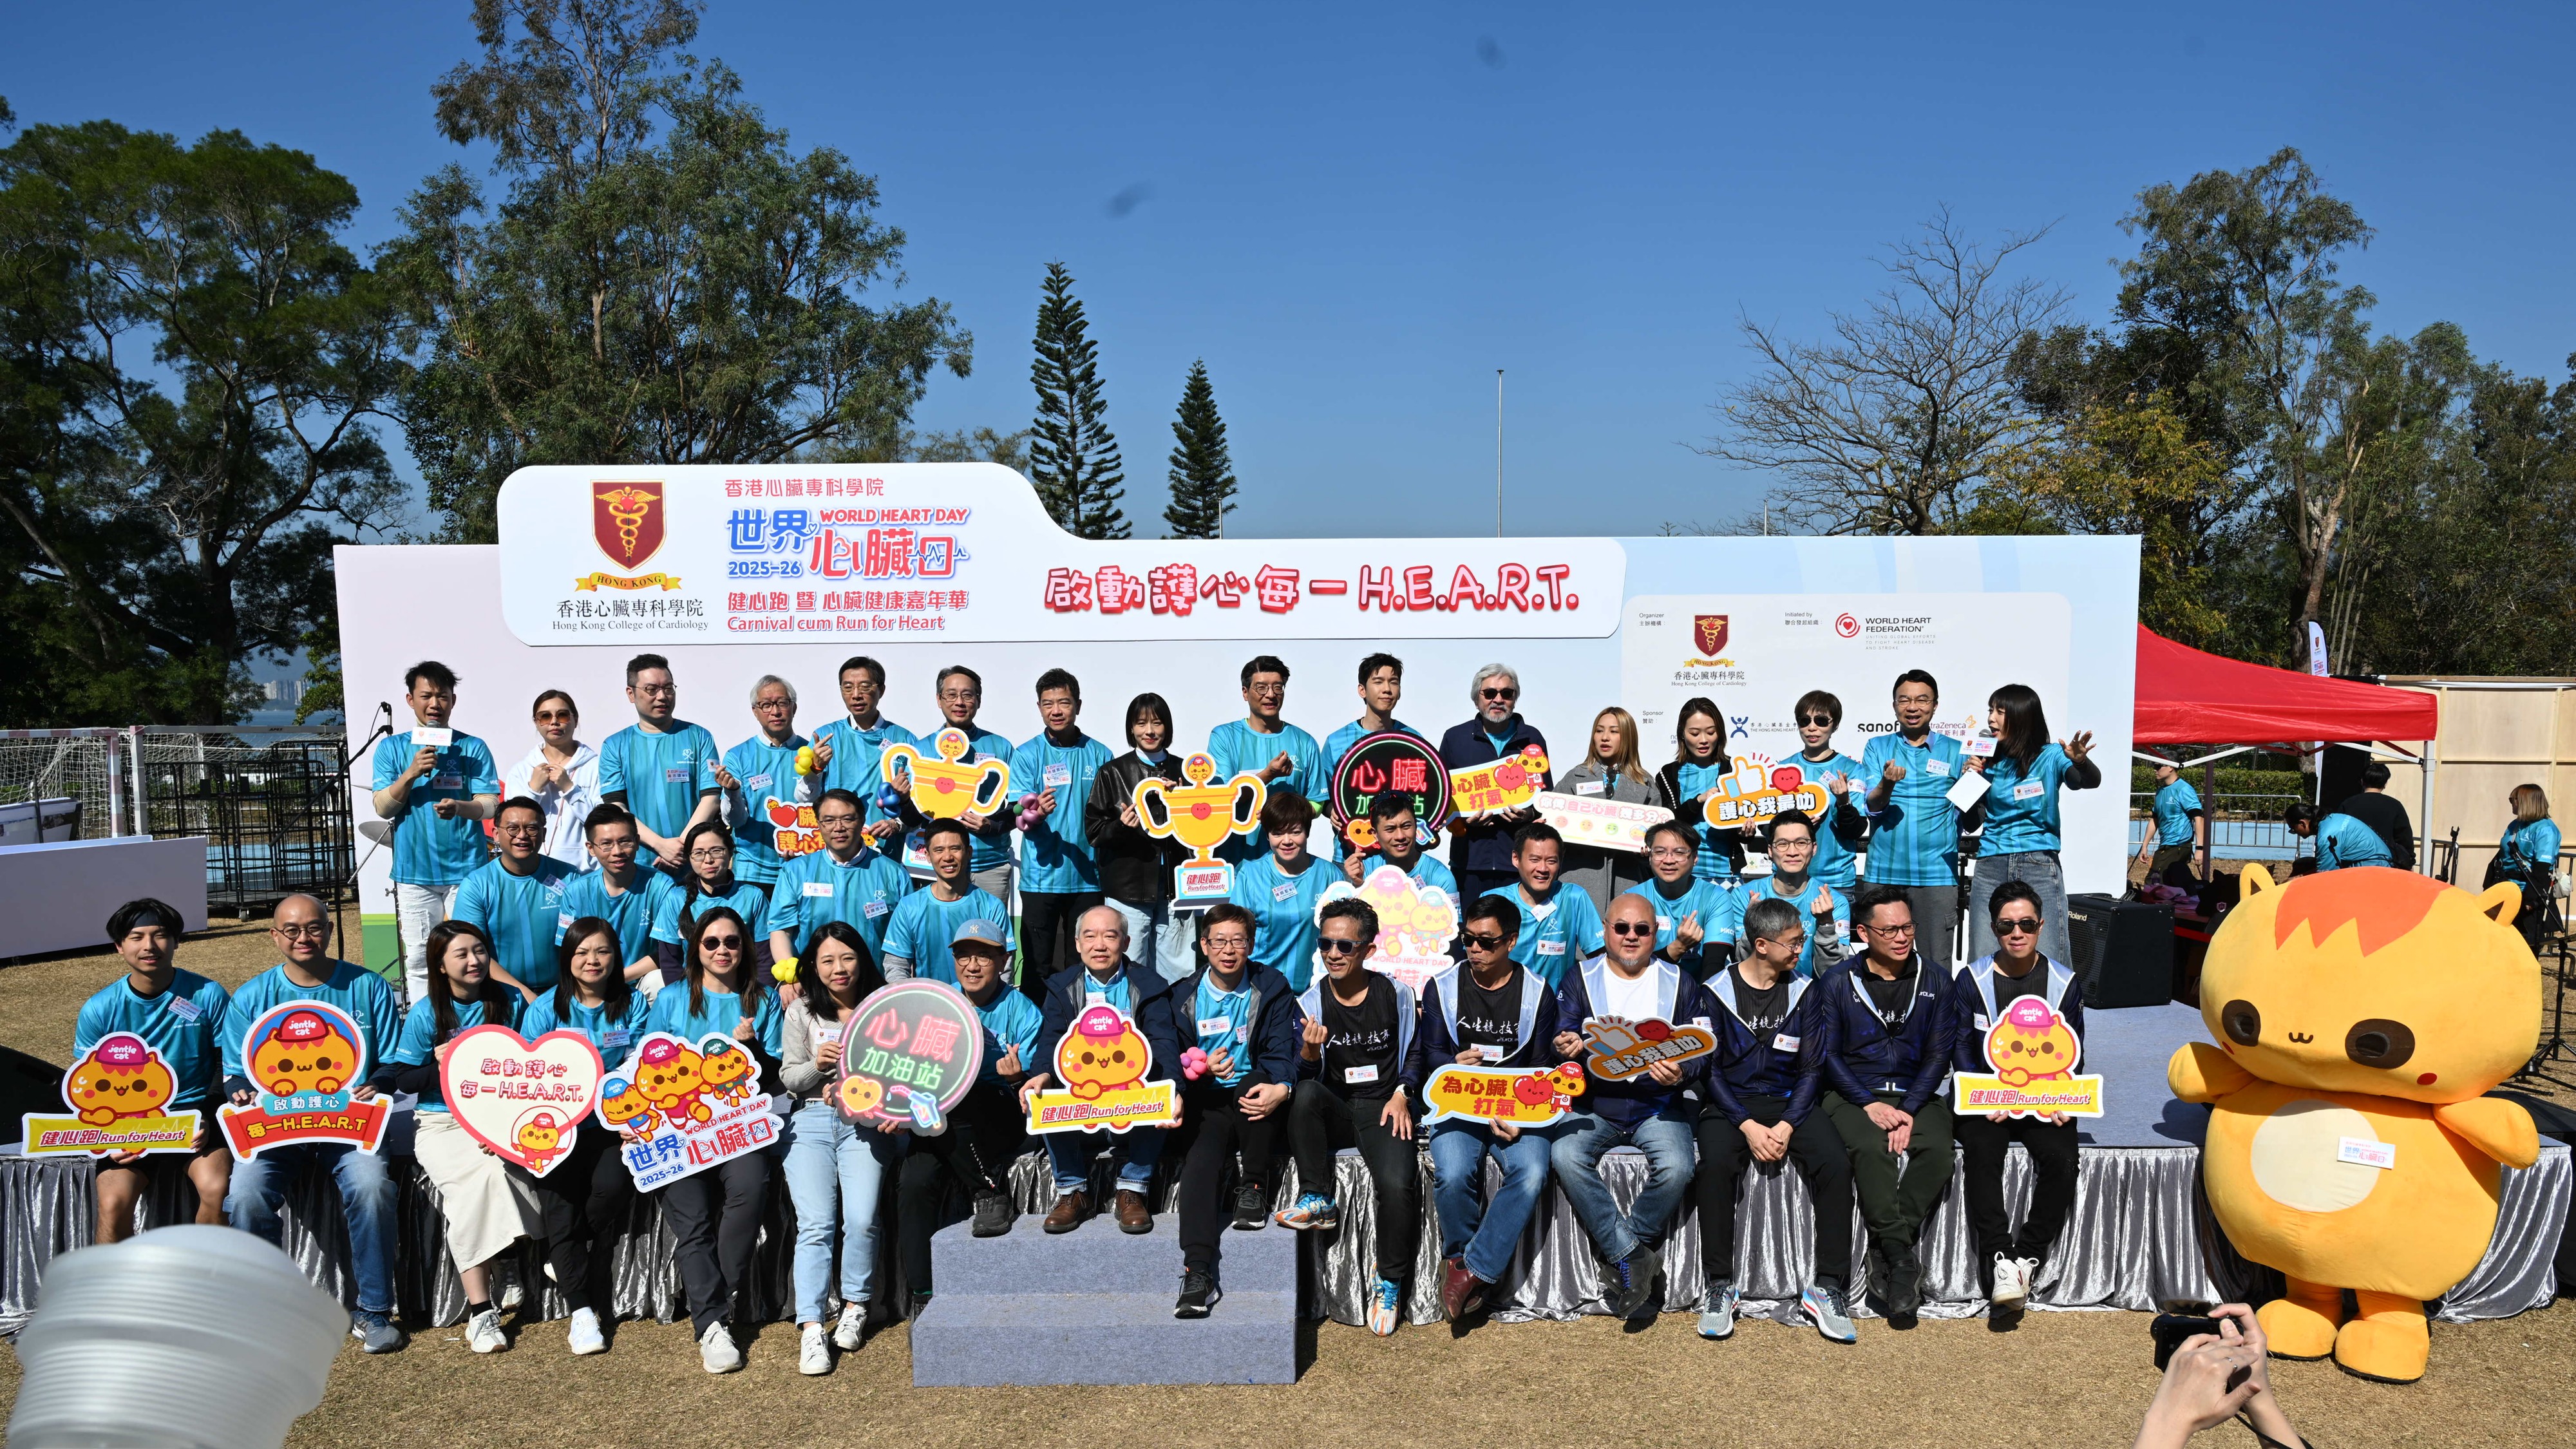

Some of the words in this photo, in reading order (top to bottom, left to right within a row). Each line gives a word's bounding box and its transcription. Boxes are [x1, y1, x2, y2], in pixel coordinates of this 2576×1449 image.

[725, 478, 884, 497] 香港心臟專科學院
[820, 509, 876, 522] WORLD
[880, 509, 931, 522] HEART
[935, 509, 968, 522] DAY
[726, 509, 814, 551] 世界
[728, 561, 801, 576] 2025-26
[597, 575, 627, 587] HONG
[632, 575, 662, 587] KONG
[556, 599, 704, 618] 香港心臟專科學院
[728, 591, 789, 611] 健心跑
[795, 591, 816, 611] 暨
[822, 590, 969, 611] 心臟健康嘉年華
[552, 621, 578, 632] Hong
[580, 621, 606, 632] Kong
[608, 620, 643, 632] College
[646, 620, 656, 629] of
[658, 620, 709, 632] Cardiology
[727, 616, 793, 631] Carnival
[797, 620, 831, 630] cum
[836, 616, 867, 630] Run
[871, 615, 895, 630] for
[898, 616, 945, 630] Heart
[1674, 671, 1745, 680] 香港心臟專科學院
[1351, 759, 1427, 793] 心臟
[1469, 788, 1504, 810] 打氣
[1718, 791, 1816, 822] 護心我最叻
[1187, 873, 1222, 885] 健心跑
[2068, 911, 2088, 922] Roland
[1403, 958, 1430, 967] HEART
[1088, 1016, 1113, 1025] jentle
[2018, 1007, 2043, 1016] jentle
[289, 1020, 316, 1030] jentle
[865, 1008, 962, 1063] 心臟
[108, 1045, 137, 1056] jentle
[649, 1044, 669, 1056] jentle
[708, 1042, 722, 1052] jentle
[1602, 1034, 1704, 1075] 護心我最叻
[480, 1058, 568, 1079] 啟動護心
[858, 1046, 944, 1090] 加油站
[1566, 1065, 1580, 1073] jentle
[460, 1080, 583, 1103] 每一H.E.A.R.T.
[1441, 1076, 1509, 1097] 為心臟
[273, 1095, 340, 1111] 啟動護心
[1969, 1090, 2018, 1105] 健心跑
[2040, 1094, 2058, 1104] for
[2058, 1094, 2090, 1104] Heart
[1041, 1103, 1092, 1122] 健心跑
[1091, 1106, 1113, 1117] Run
[1113, 1104, 1131, 1116] for
[1132, 1101, 1163, 1113] Heart
[1473, 1098, 1517, 1118] 打氣
[247, 1115, 367, 1139] 每一H.E.A.R.T
[684, 1119, 717, 1137] WORLD
[718, 1107, 748, 1126] HEART
[748, 1099, 768, 1116] DAY
[39, 1129, 101, 1146] 健心跑
[100, 1133, 125, 1143] Run
[128, 1132, 147, 1142] for
[148, 1130, 185, 1141] Heart
[628, 1133, 684, 1173] 世界
[639, 1164, 685, 1186] 2025-26
